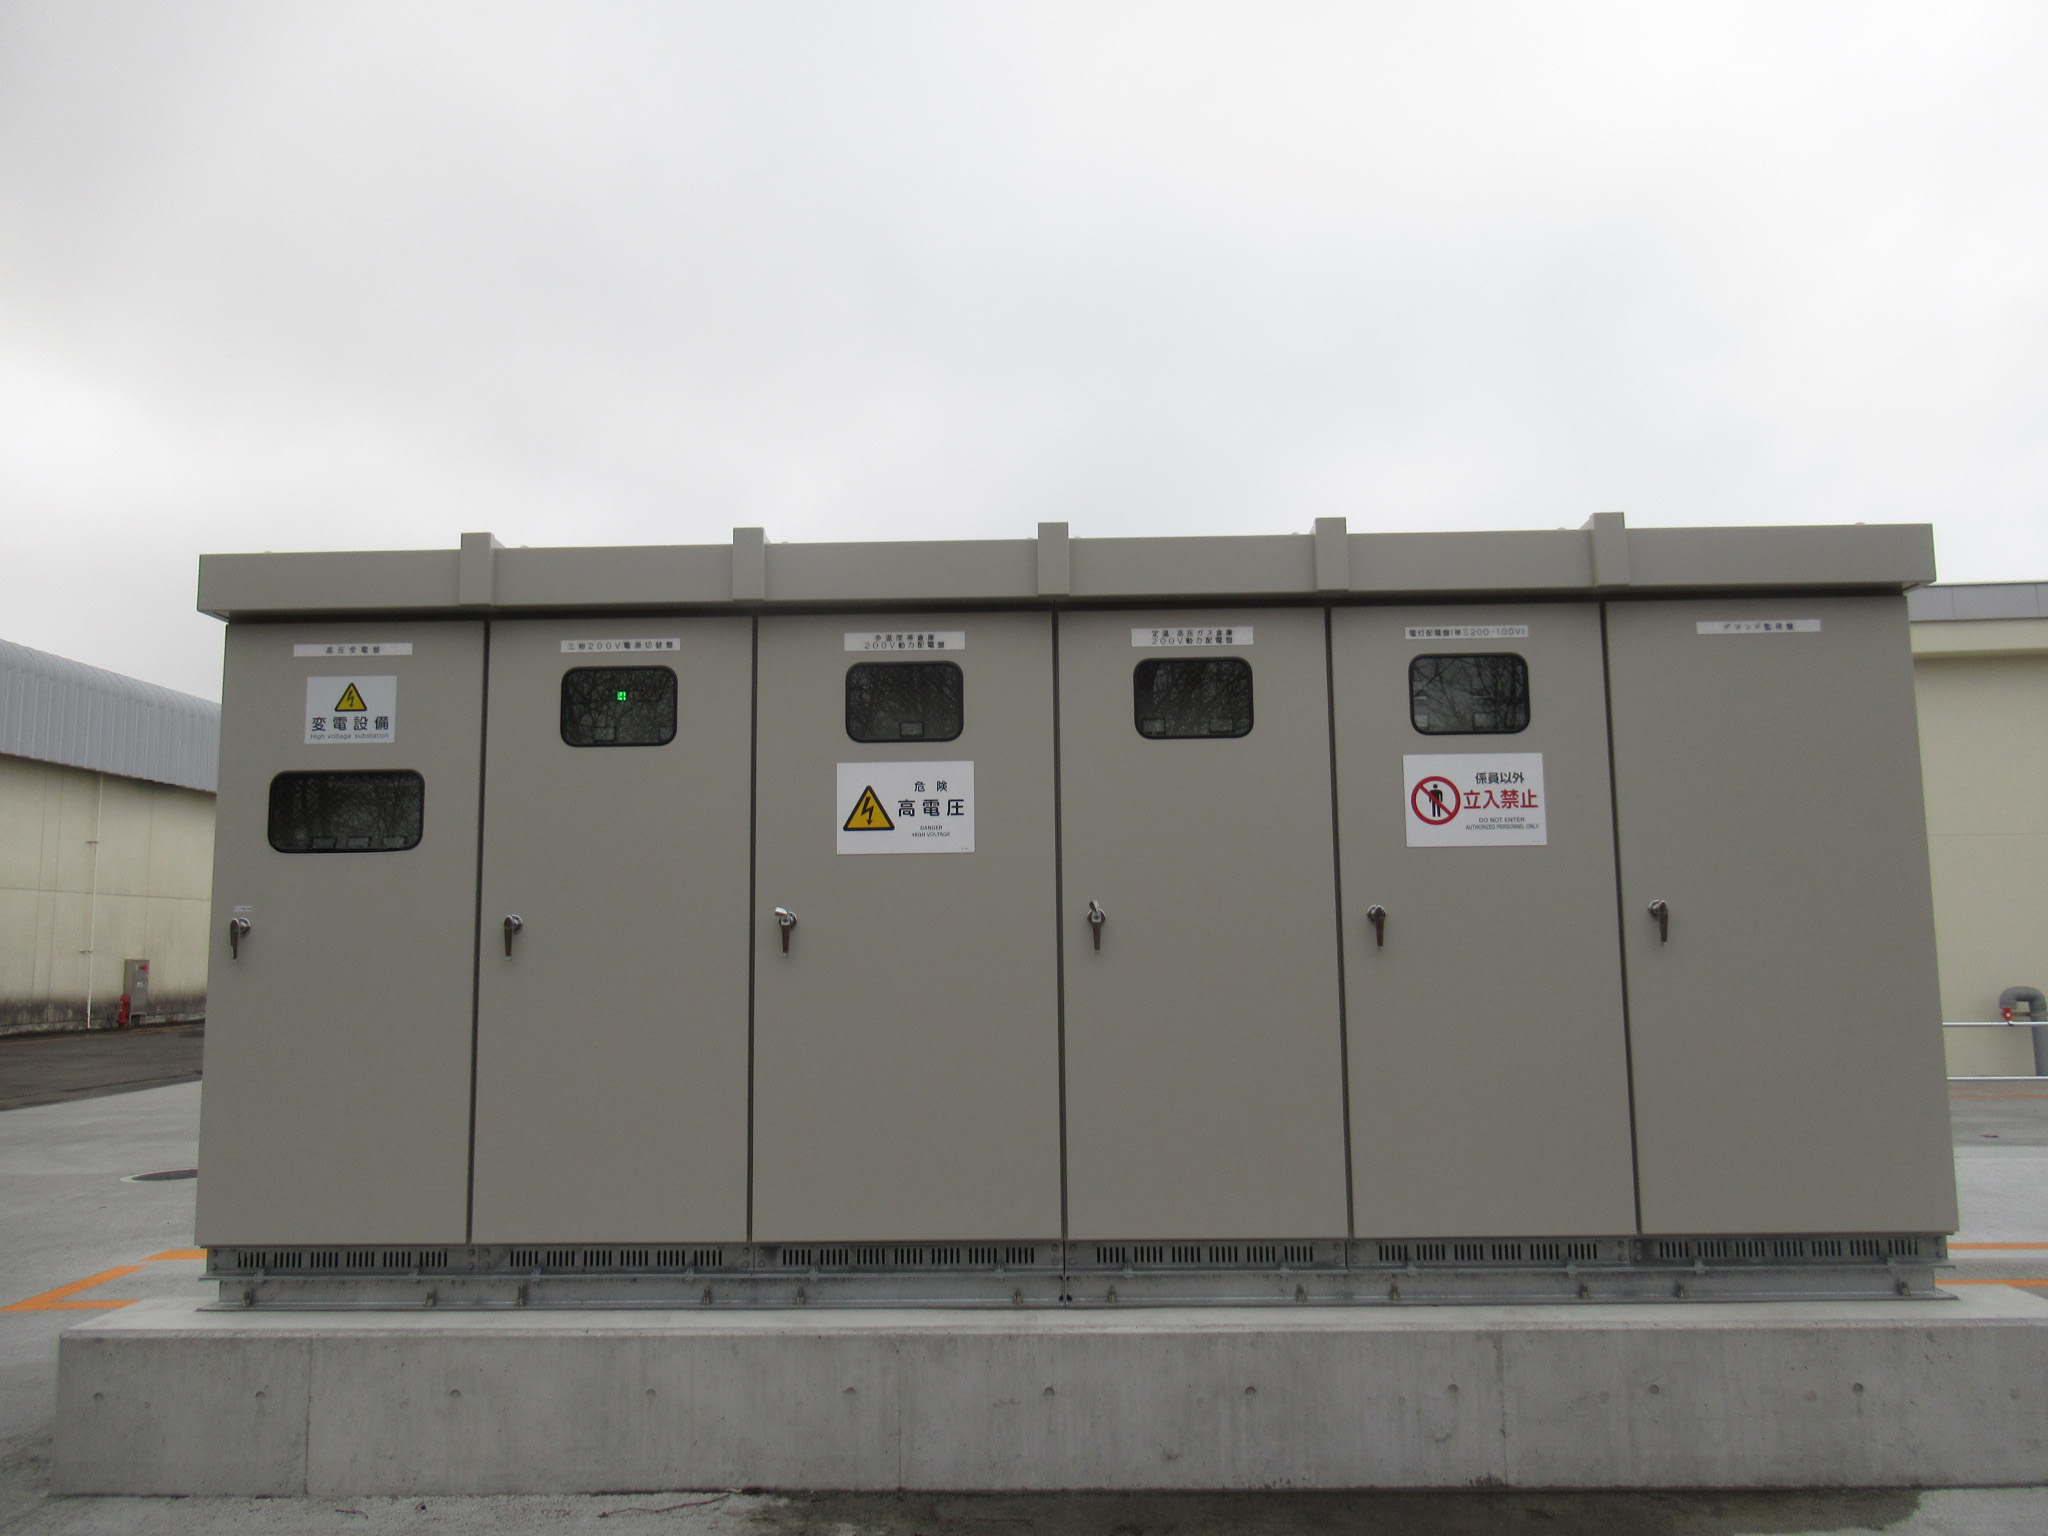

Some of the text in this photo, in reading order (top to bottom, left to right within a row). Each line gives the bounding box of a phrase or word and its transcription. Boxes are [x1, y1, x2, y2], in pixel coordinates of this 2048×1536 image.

[312, 716, 389, 731] 変電設備
[1475, 772, 1525, 784] 係員以外
[914, 781, 948, 792] 危険
[1463, 789, 1539, 809] 立入禁止
[898, 799, 965, 817] 高電圧
